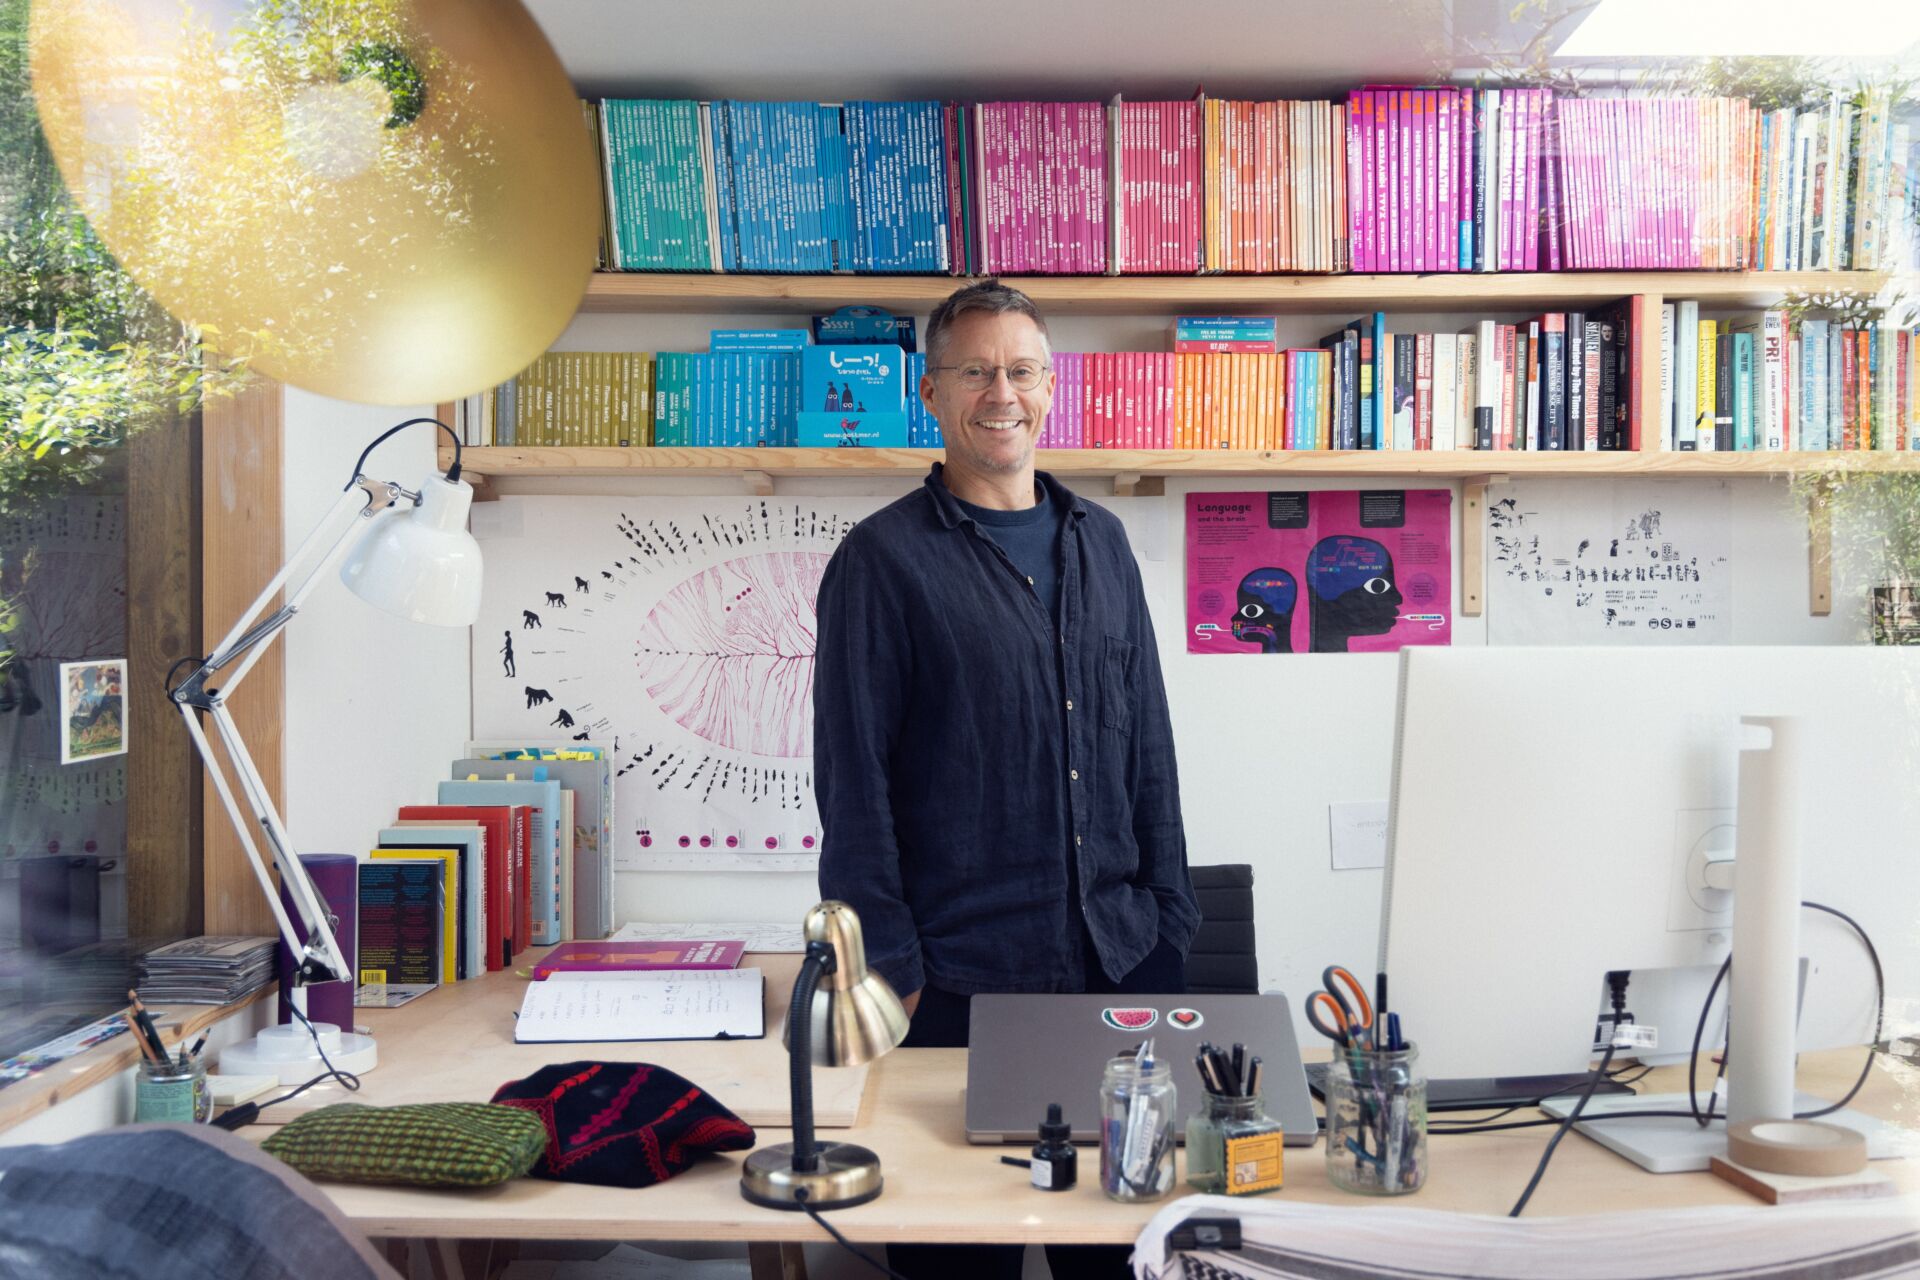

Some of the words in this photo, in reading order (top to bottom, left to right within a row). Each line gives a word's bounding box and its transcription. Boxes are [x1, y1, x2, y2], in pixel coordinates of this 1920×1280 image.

[1586, 322, 1599, 352] STANLEY
[1765, 337, 1780, 363] PR!
[1572, 338, 1581, 365] Buried
[1586, 354, 1598, 368] HOW
[1571, 366, 1581, 377] by
[1604, 351, 1615, 393] SELLING
[1700, 339, 1709, 407] INFORMATION
[1572, 378, 1581, 393] The
[1586, 371, 1598, 416] PROPAGANDA
[1571, 395, 1580, 419] Times
[1604, 395, 1615, 432] HITLER
[1586, 417, 1598, 441] WORKS
[1197, 504, 1252, 514] Language
